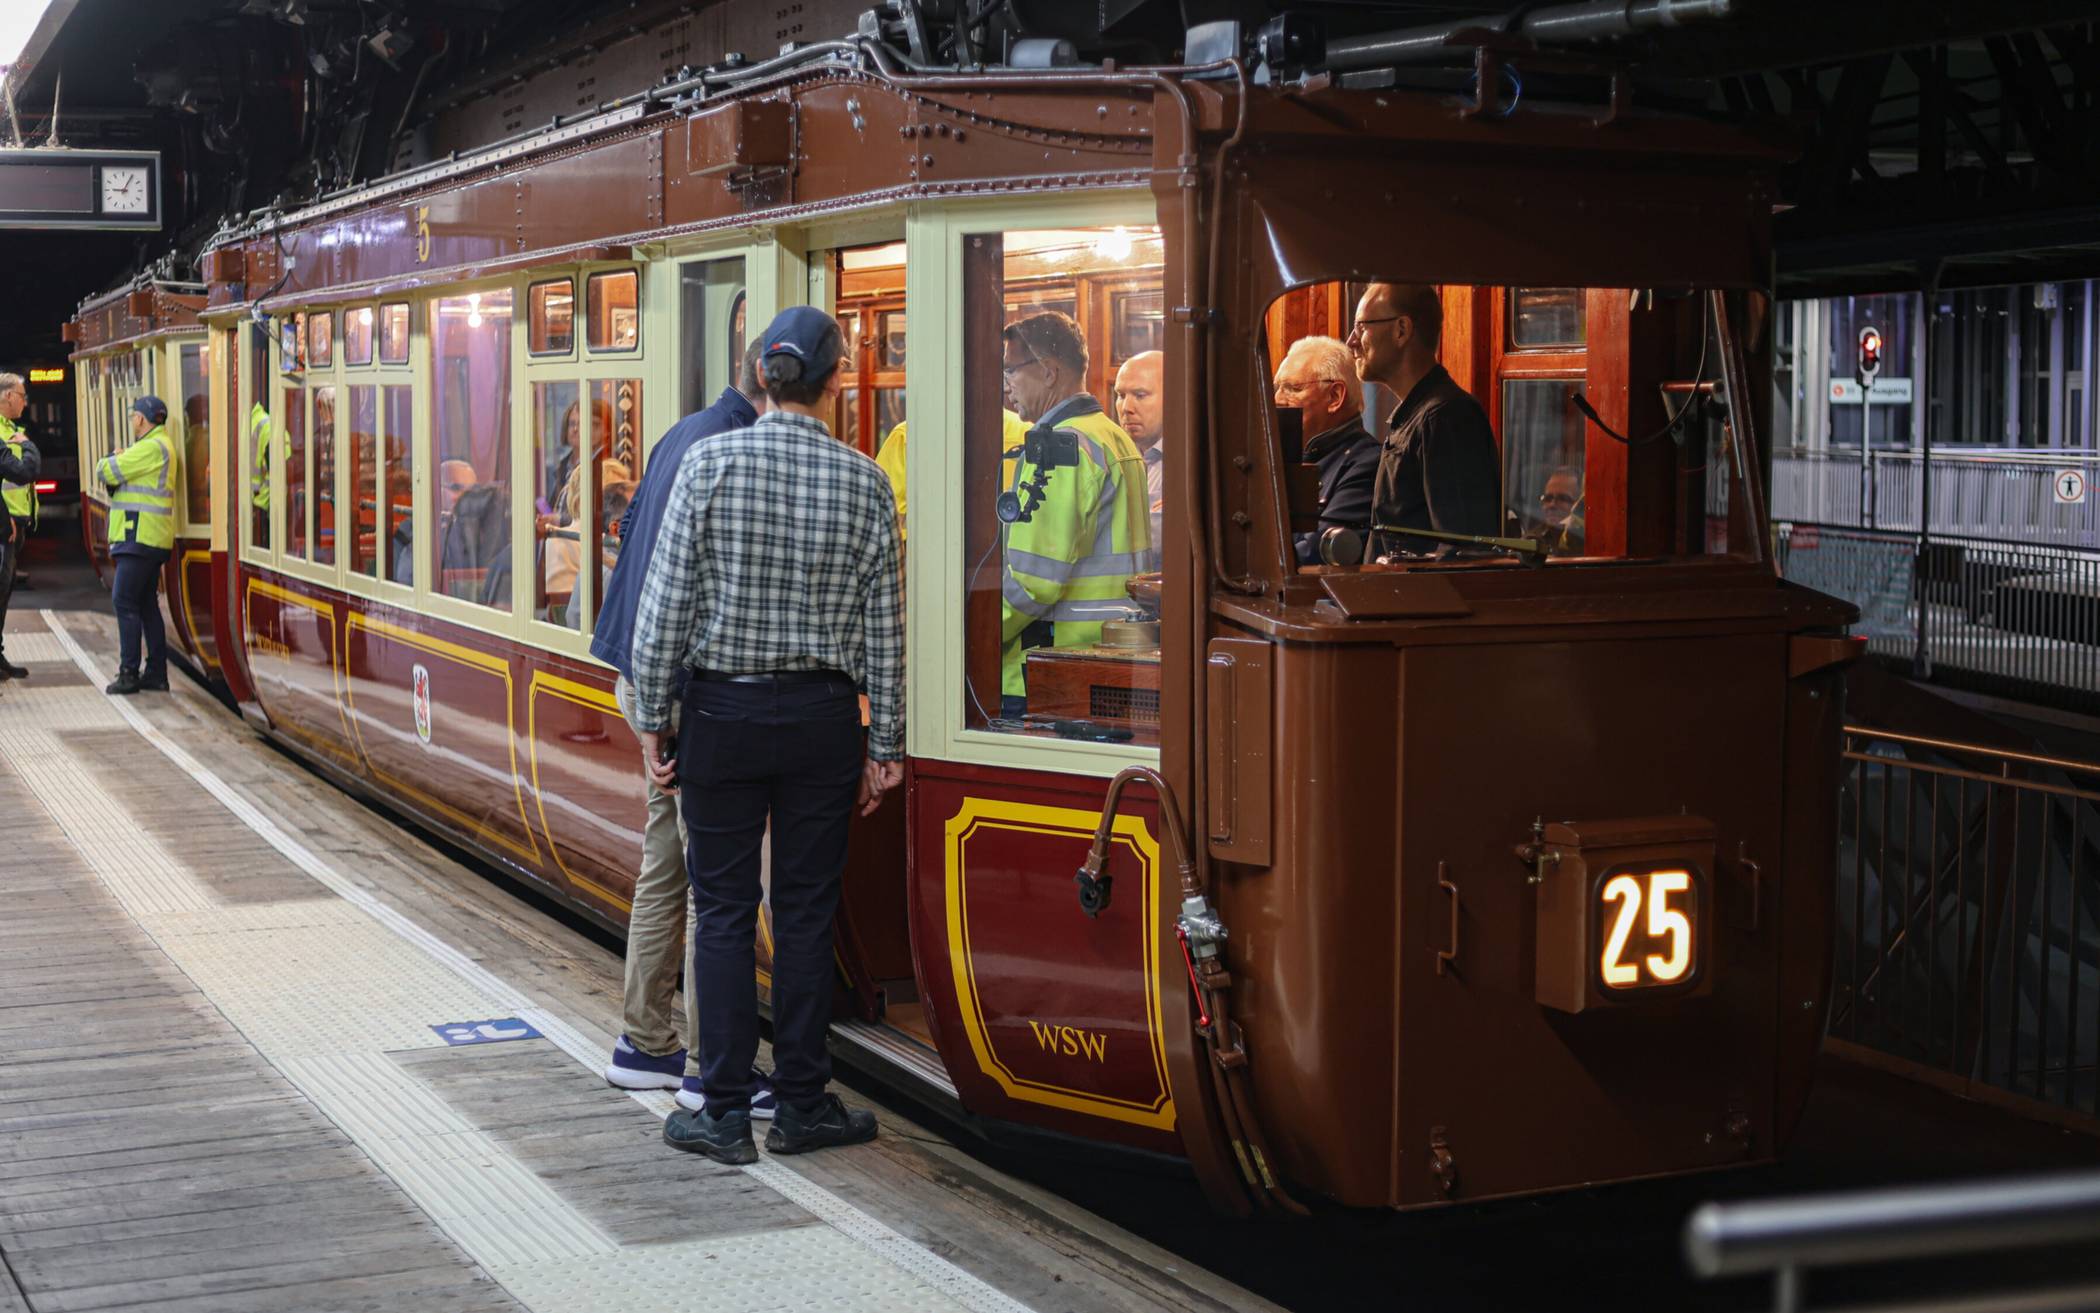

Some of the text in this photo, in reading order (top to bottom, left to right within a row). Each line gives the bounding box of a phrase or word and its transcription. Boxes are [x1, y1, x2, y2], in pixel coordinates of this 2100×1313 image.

[419, 206, 430, 262] 5
[1601, 870, 1691, 984] 25
[1028, 1020, 1107, 1064] WSW
